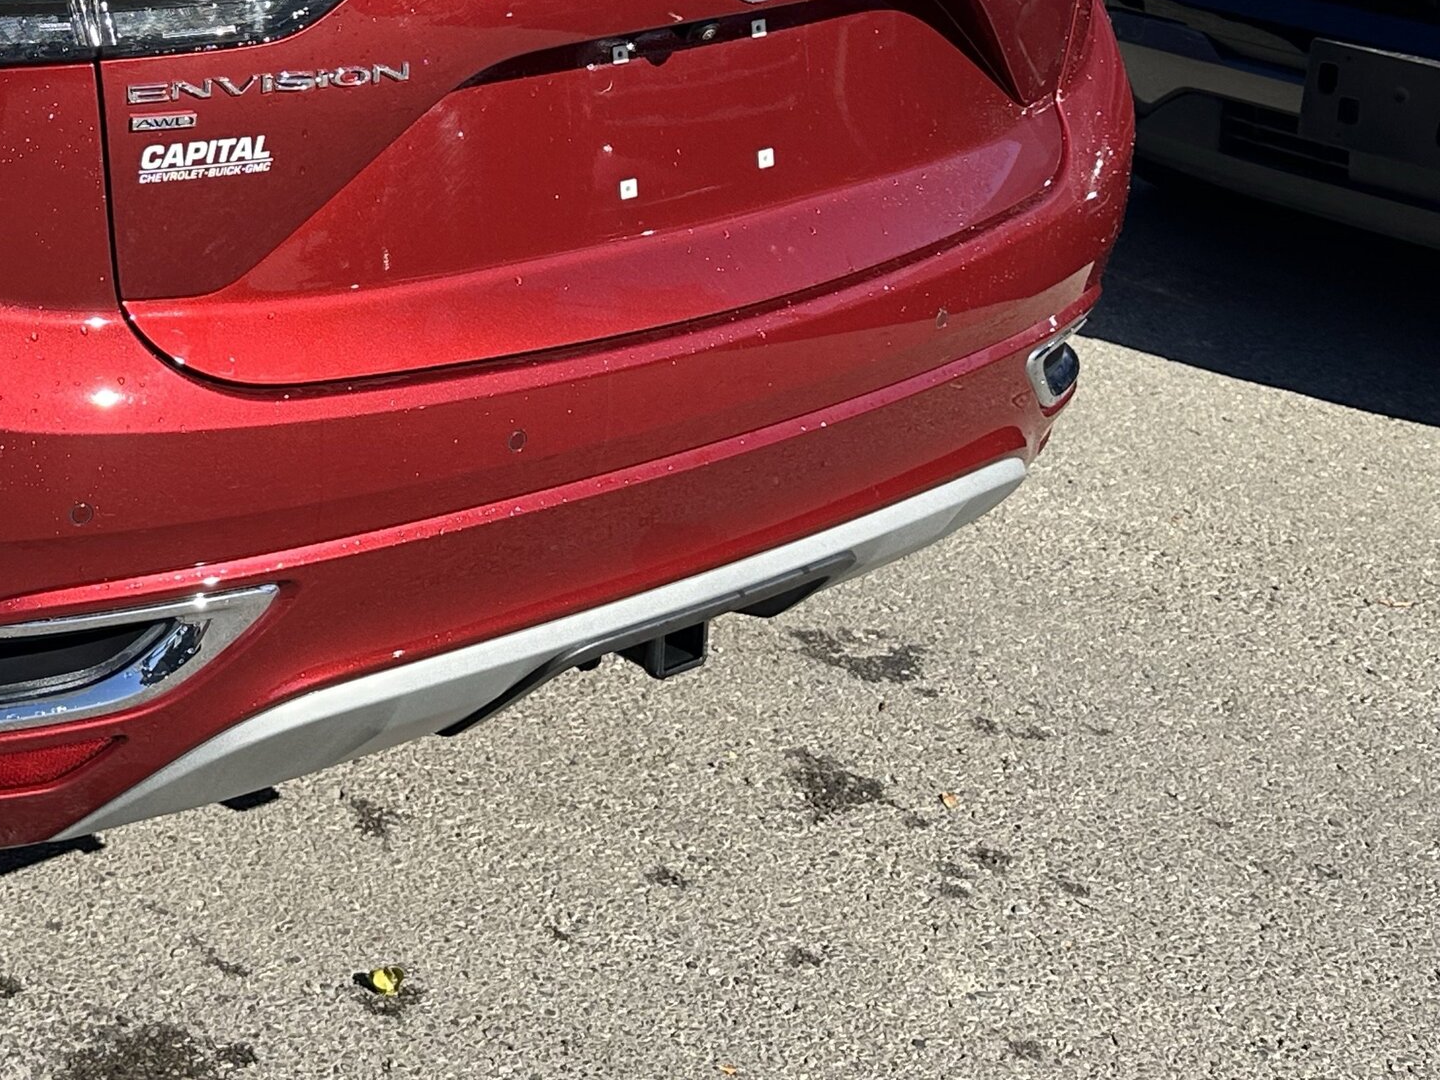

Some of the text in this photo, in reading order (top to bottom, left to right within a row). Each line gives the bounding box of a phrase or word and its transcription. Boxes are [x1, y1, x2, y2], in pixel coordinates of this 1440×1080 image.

[127, 61, 410, 104] ENVISION
[133, 114, 196, 129] AWD
[140, 135, 270, 170] CAPITAL
